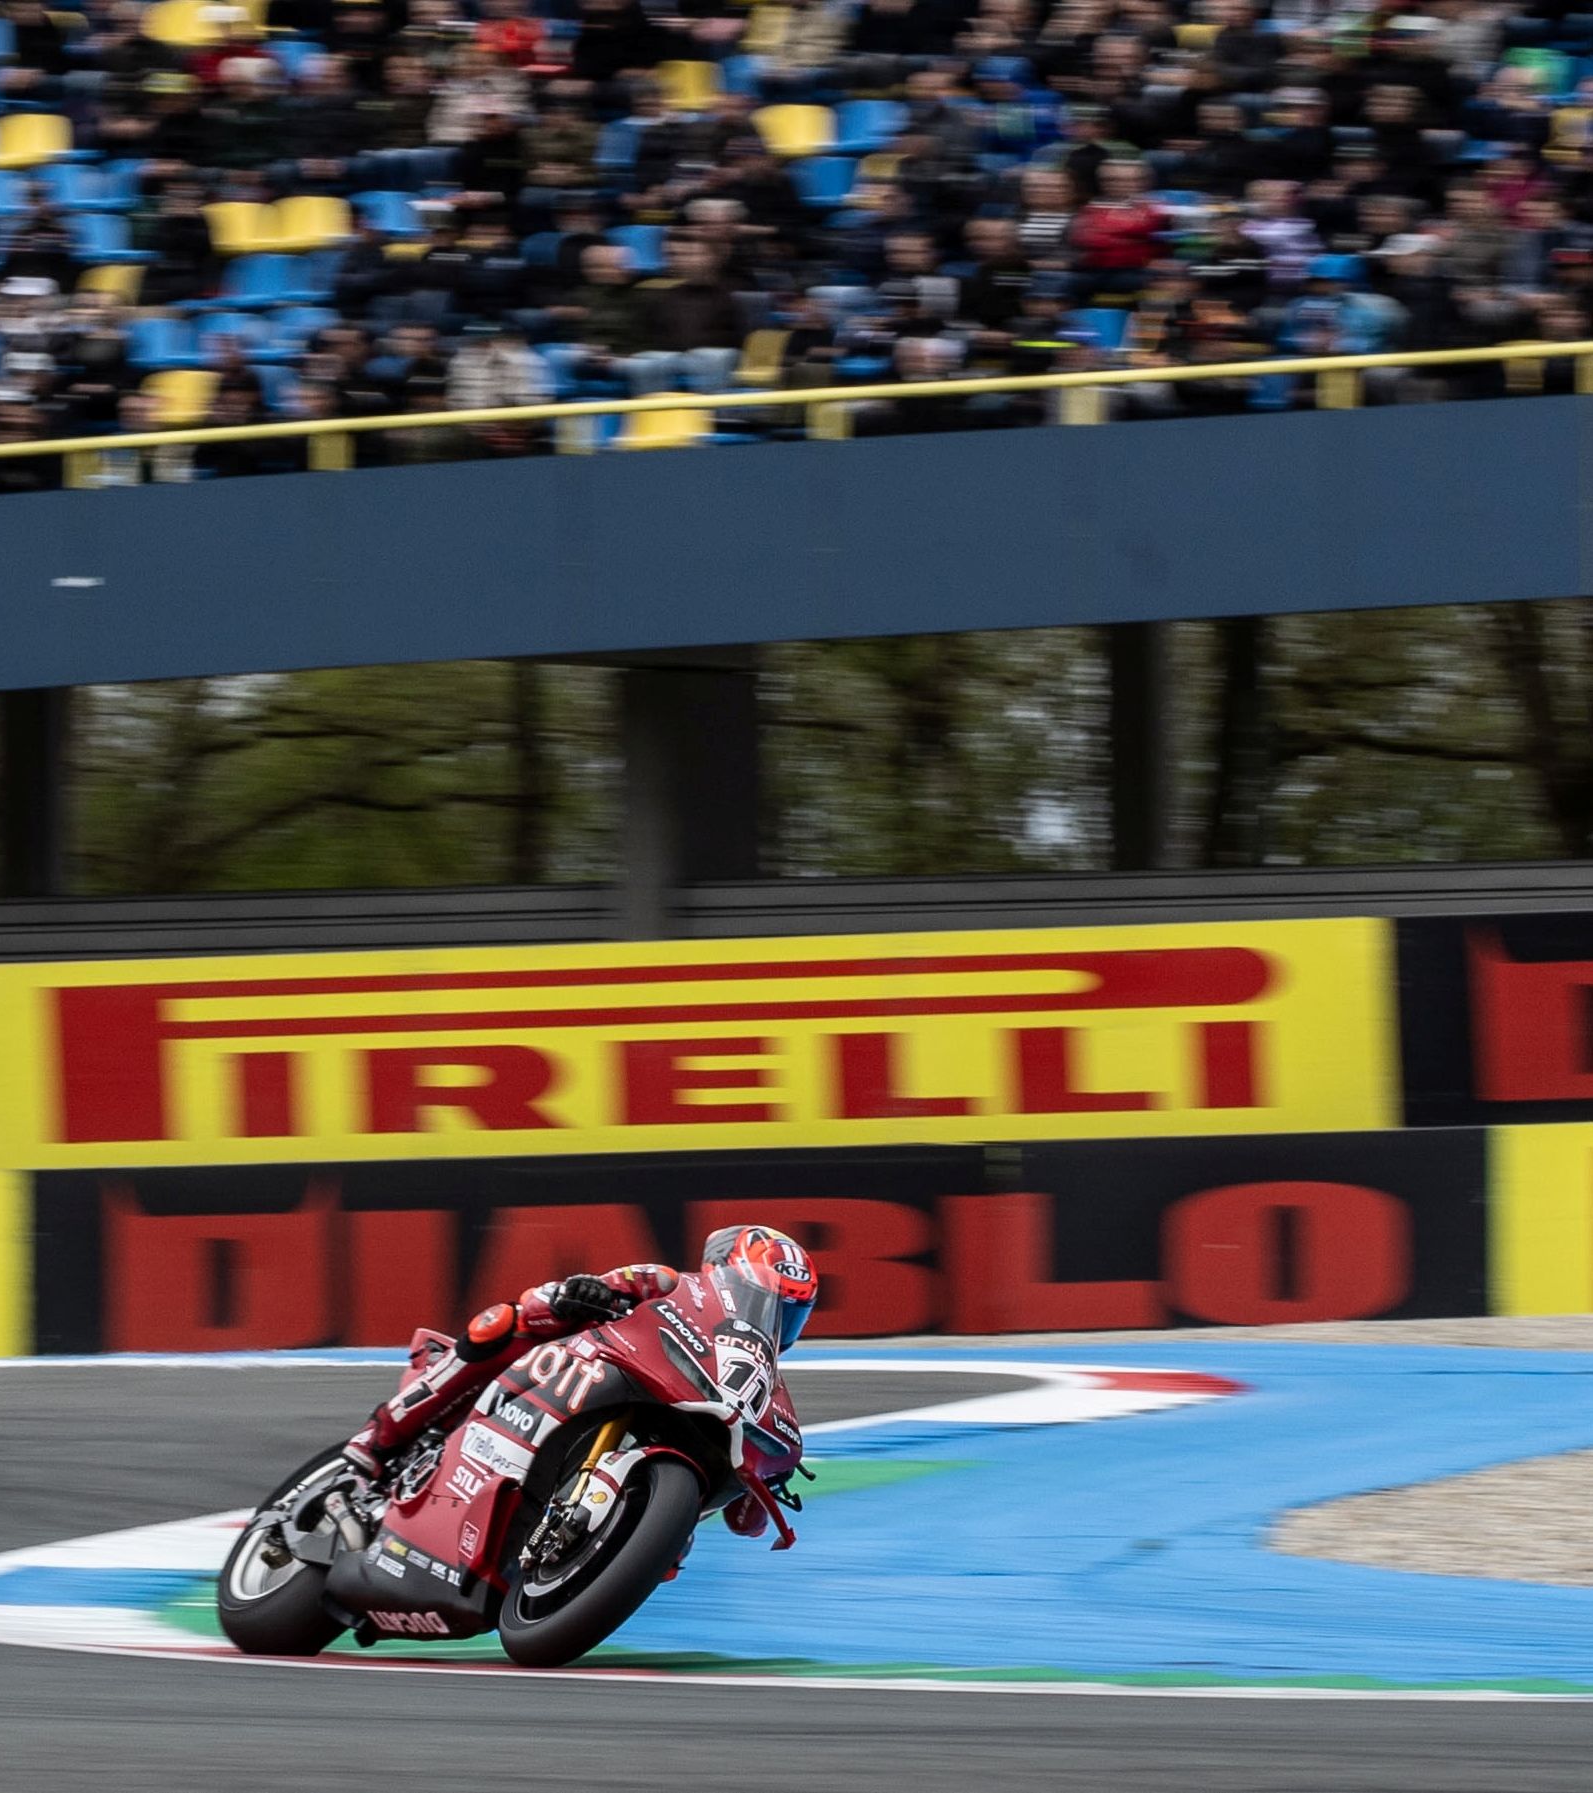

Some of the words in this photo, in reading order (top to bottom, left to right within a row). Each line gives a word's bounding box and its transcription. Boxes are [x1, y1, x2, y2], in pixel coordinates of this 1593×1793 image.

[42, 946, 1286, 1143] PIRELLI
[102, 1178, 1411, 1353] DIABLO
[656, 1303, 705, 1354] Lenovo
[494, 1393, 534, 1432] Lovo
[719, 1356, 769, 1422] 11
